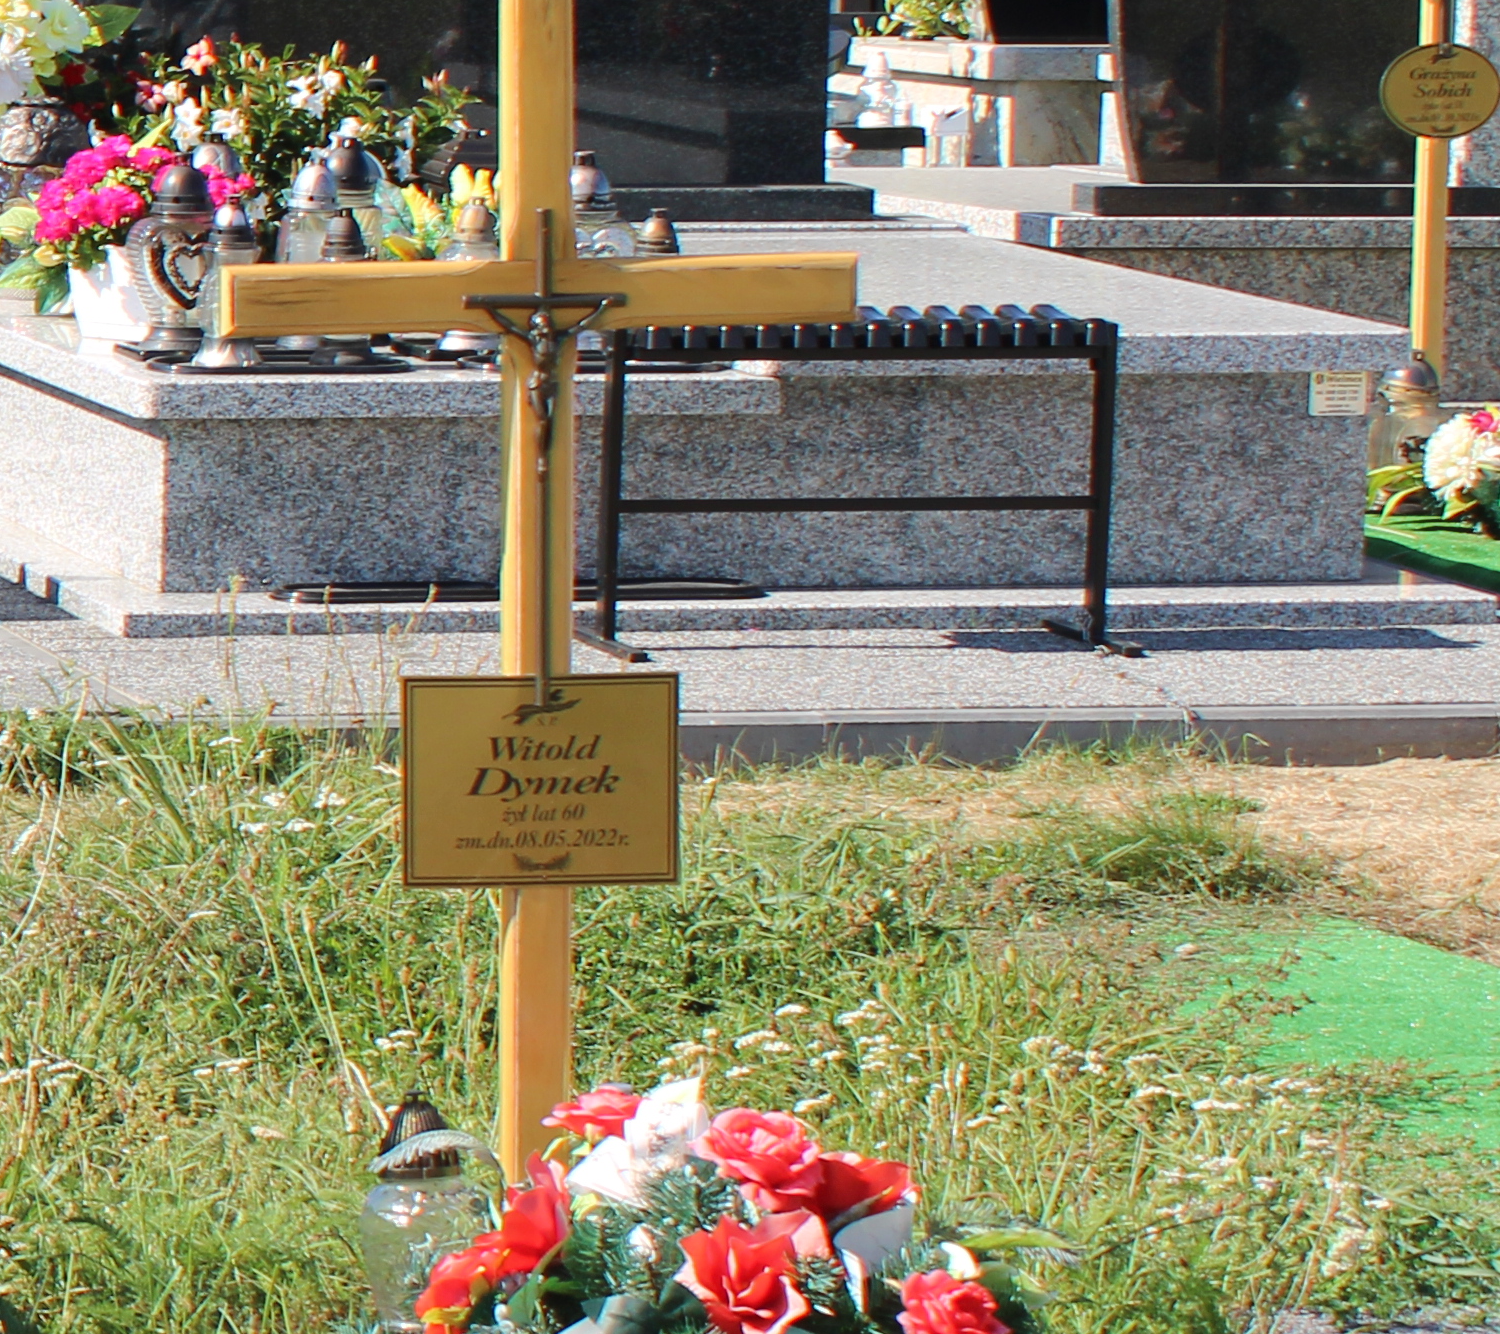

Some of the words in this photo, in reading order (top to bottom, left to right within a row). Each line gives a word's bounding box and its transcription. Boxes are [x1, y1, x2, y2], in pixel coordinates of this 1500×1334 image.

[489, 735, 601, 762] Witold
[466, 764, 620, 803] Dymek
[532, 803, 557, 822] lat
[562, 803, 584, 820] 60
